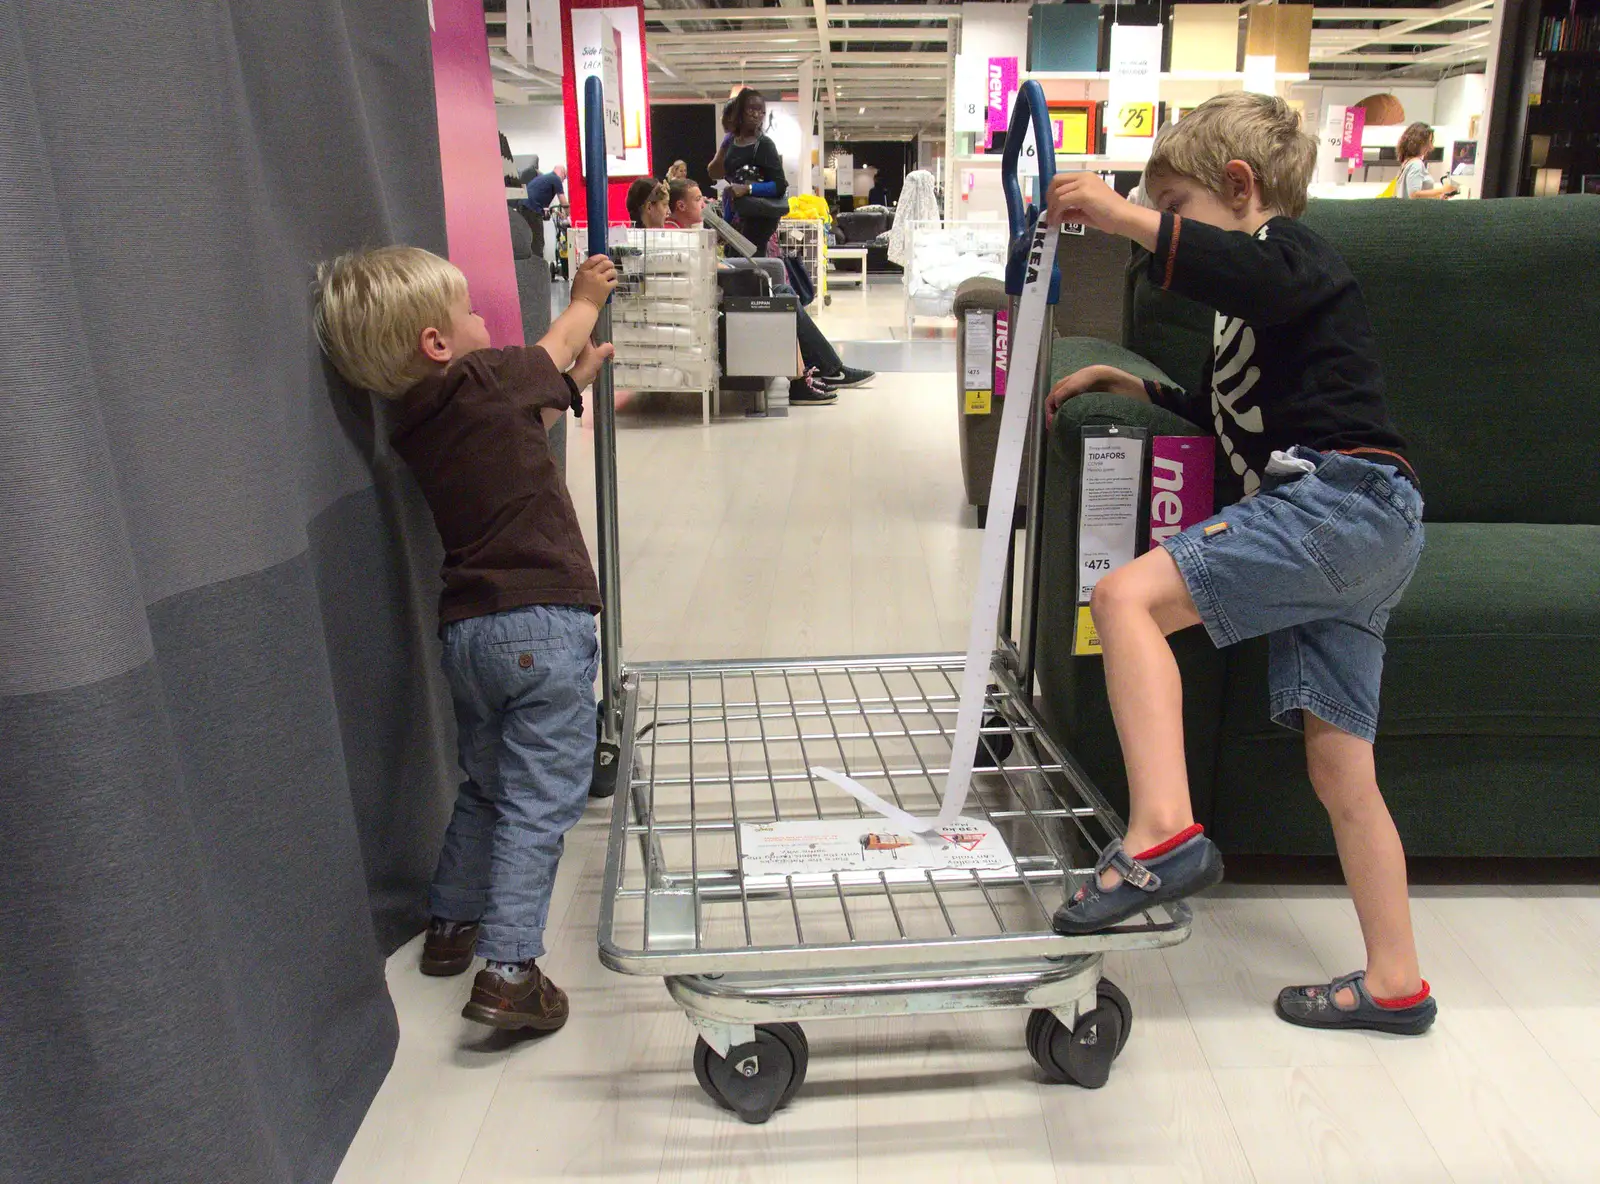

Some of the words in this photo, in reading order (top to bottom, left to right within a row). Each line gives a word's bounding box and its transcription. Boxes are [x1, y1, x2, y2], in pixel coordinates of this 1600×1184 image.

[582, 46, 597, 56] Side
[989, 65, 1003, 111] new
[1344, 112, 1355, 145] new
[1025, 221, 1048, 285] IKEA
[995, 319, 1009, 371] new
[1088, 452, 1126, 460] TIDAFORS
[1084, 559, 1110, 570] £475
